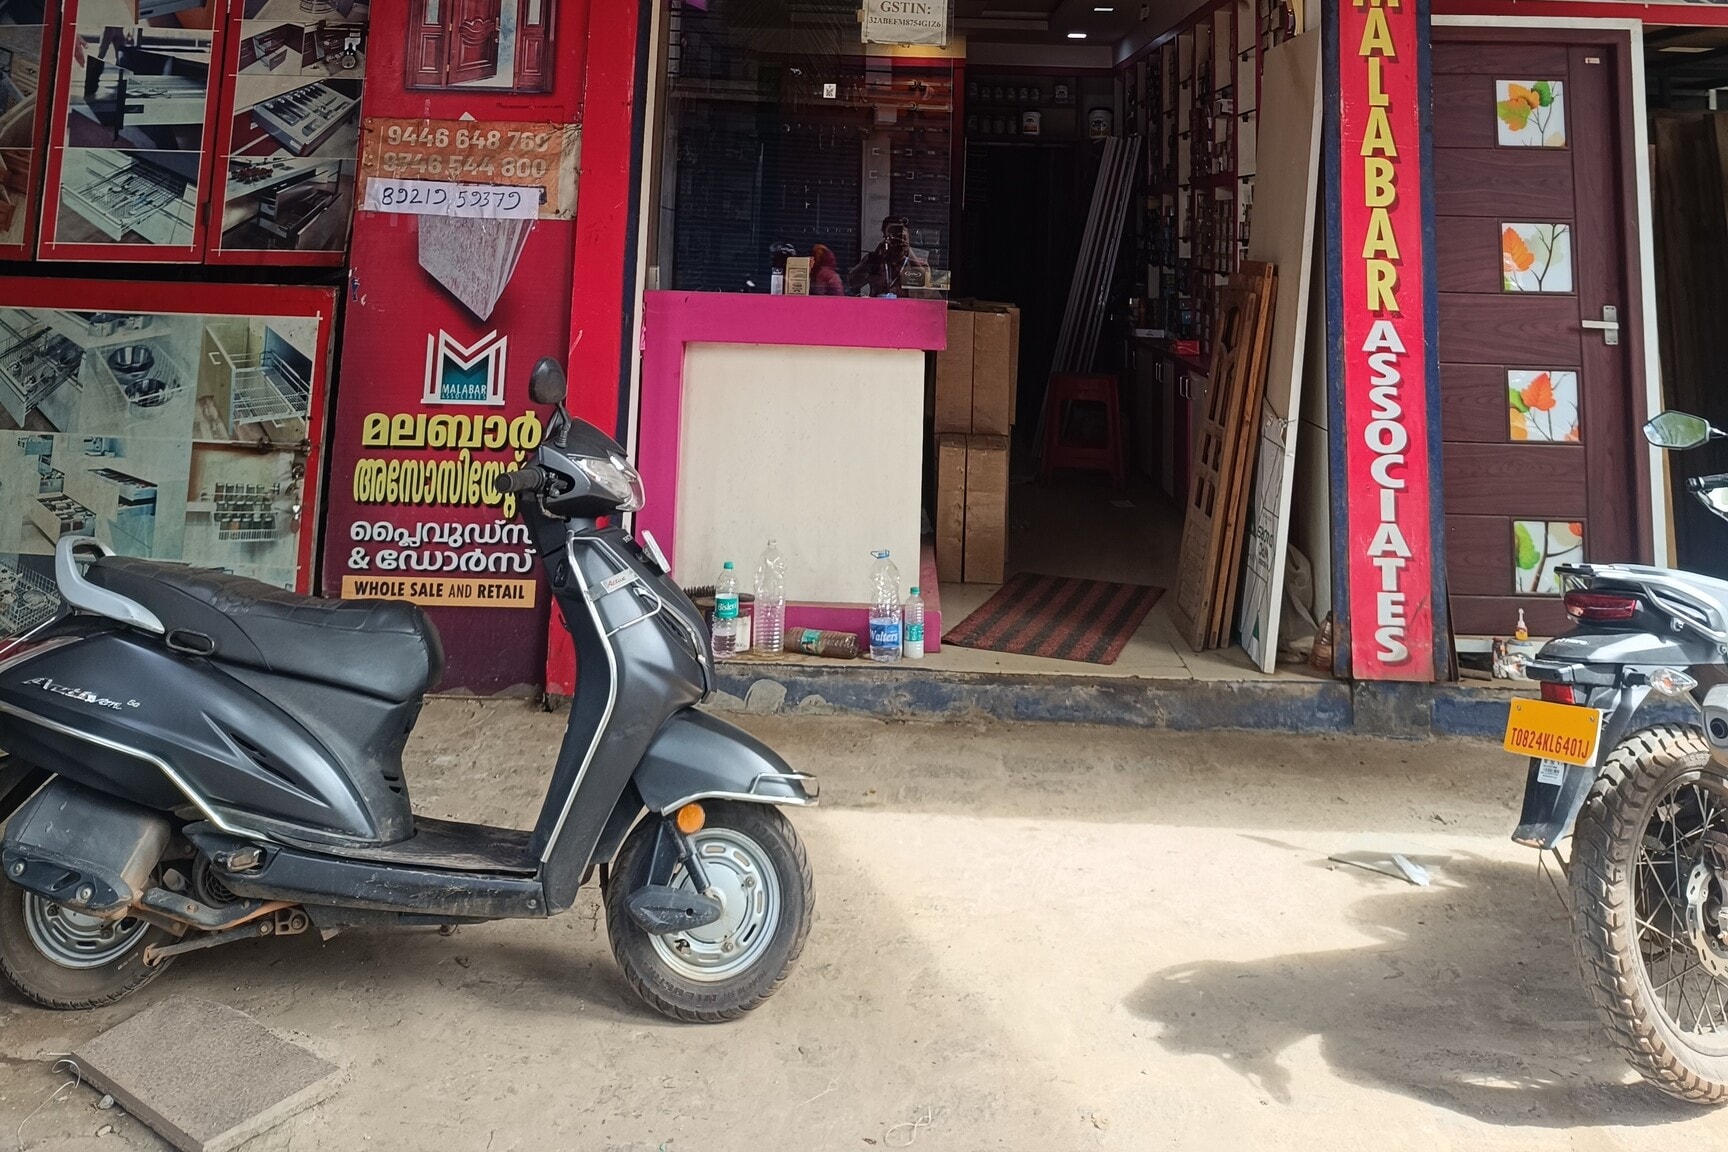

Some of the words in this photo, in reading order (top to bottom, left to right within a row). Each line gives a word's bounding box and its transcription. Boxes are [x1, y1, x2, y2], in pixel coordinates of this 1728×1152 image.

[880, 0, 932, 15] GSTIN:
[387, 125, 450, 148] 9446
[455, 129, 501, 150] 648
[448, 155, 495, 177] 544
[501, 158, 547, 178] 800
[441, 383, 487, 394] MALABAR
[1361, 319, 1413, 663] ASSOCIATES
[347, 546, 370, 570] &
[354, 580, 405, 597] WHOLE
[409, 582, 444, 598] SALE
[448, 583, 472, 598] AND
[477, 583, 525, 599] RETAIL
